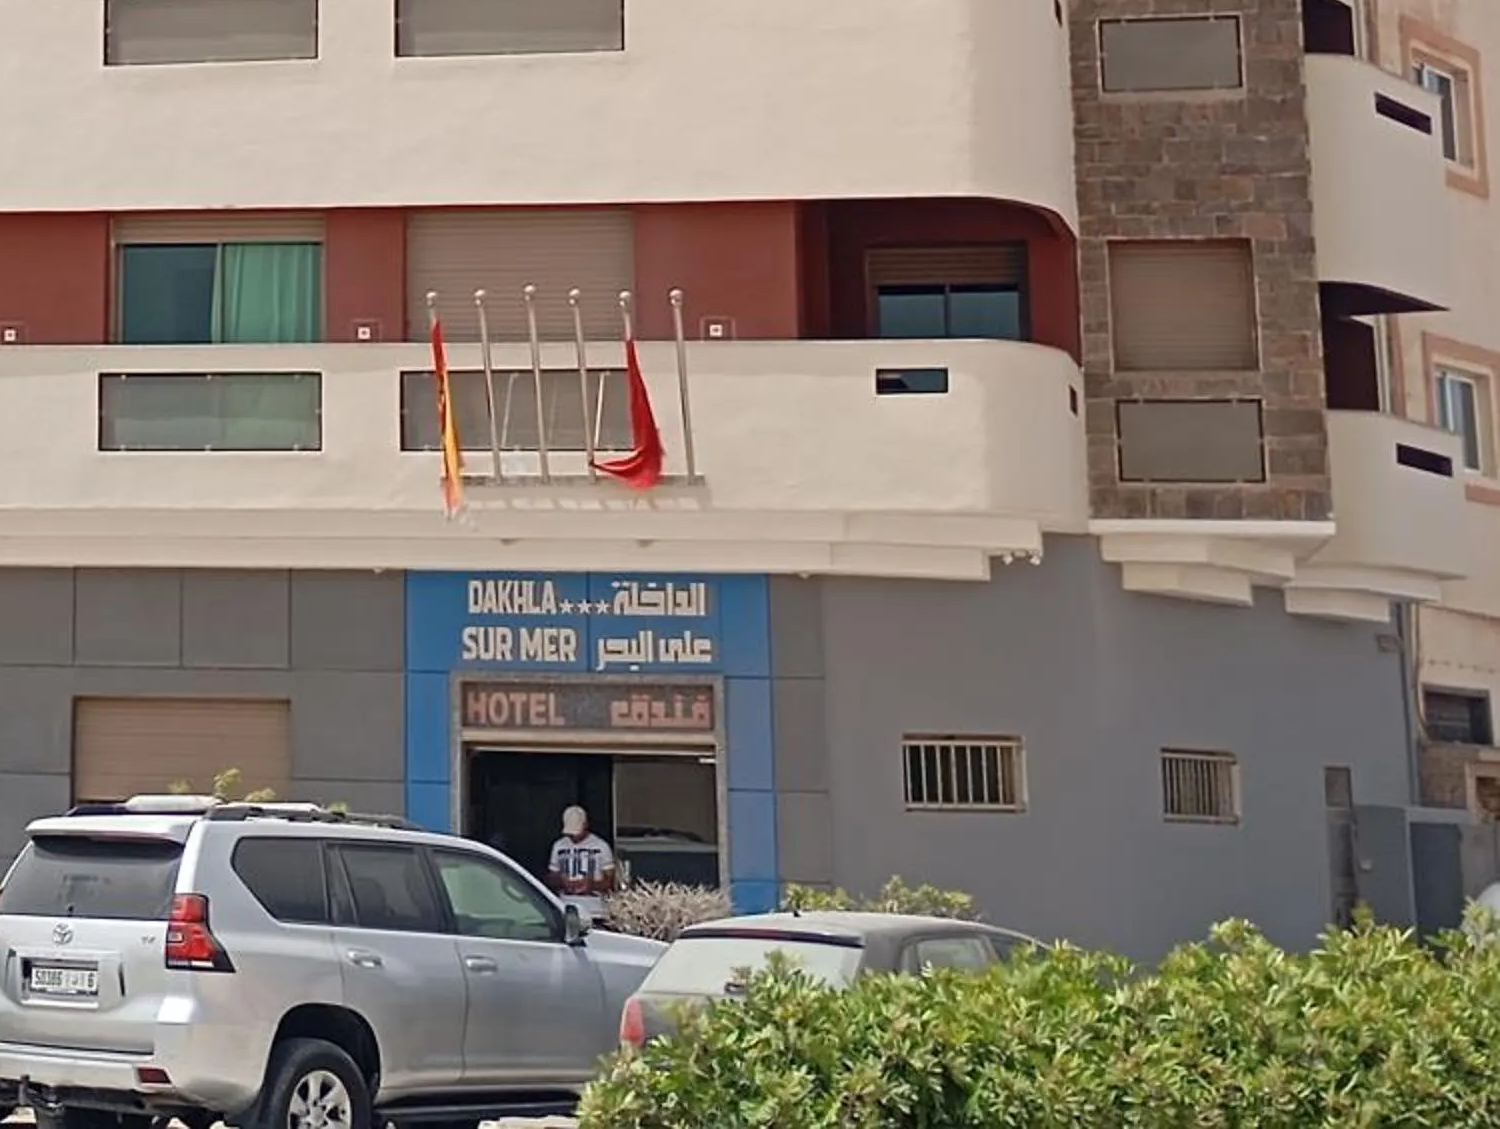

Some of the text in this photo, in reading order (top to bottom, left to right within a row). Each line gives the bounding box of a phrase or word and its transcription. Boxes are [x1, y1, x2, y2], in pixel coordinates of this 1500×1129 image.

[467, 580, 558, 615] DAKHLA
[610, 580, 707, 617] الداخلة
[461, 626, 578, 662] SUR MER
[595, 630, 654, 672] البحر
[466, 692, 566, 727] HOTEL
[609, 694, 713, 729] فندق
